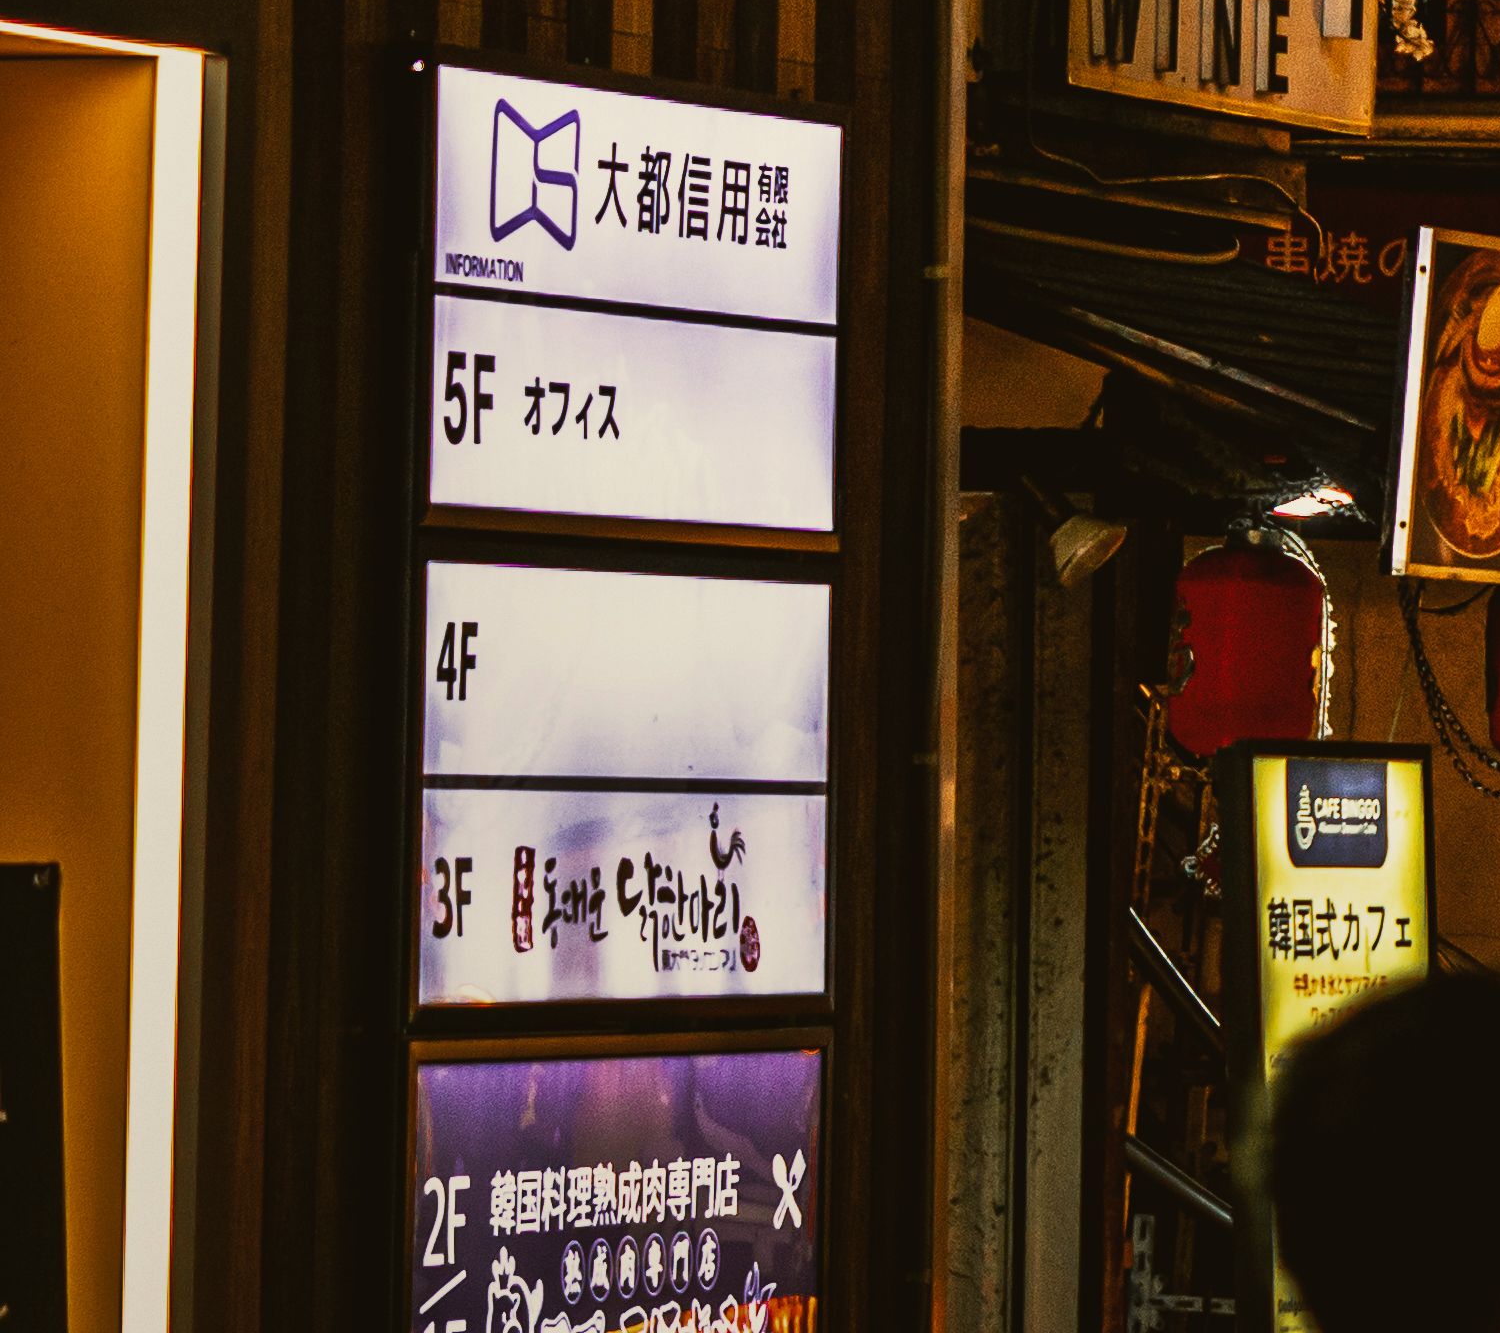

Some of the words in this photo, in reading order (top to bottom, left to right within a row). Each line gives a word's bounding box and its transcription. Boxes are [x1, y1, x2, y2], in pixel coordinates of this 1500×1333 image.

[594, 141, 753, 247] 大都信用
[444, 251, 525, 283] INFORMATION
[443, 349, 497, 446] 5F
[523, 376, 621, 440] オフィス
[435, 621, 480, 702] 4F
[1314, 796, 1341, 821] CAFE
[431, 856, 475, 940] 3F
[1266, 896, 1413, 961] 韓国式カフェ
[421, 1174, 472, 1268] 2F
[489, 1151, 742, 1238] 韓国料理熟成肉専門店
